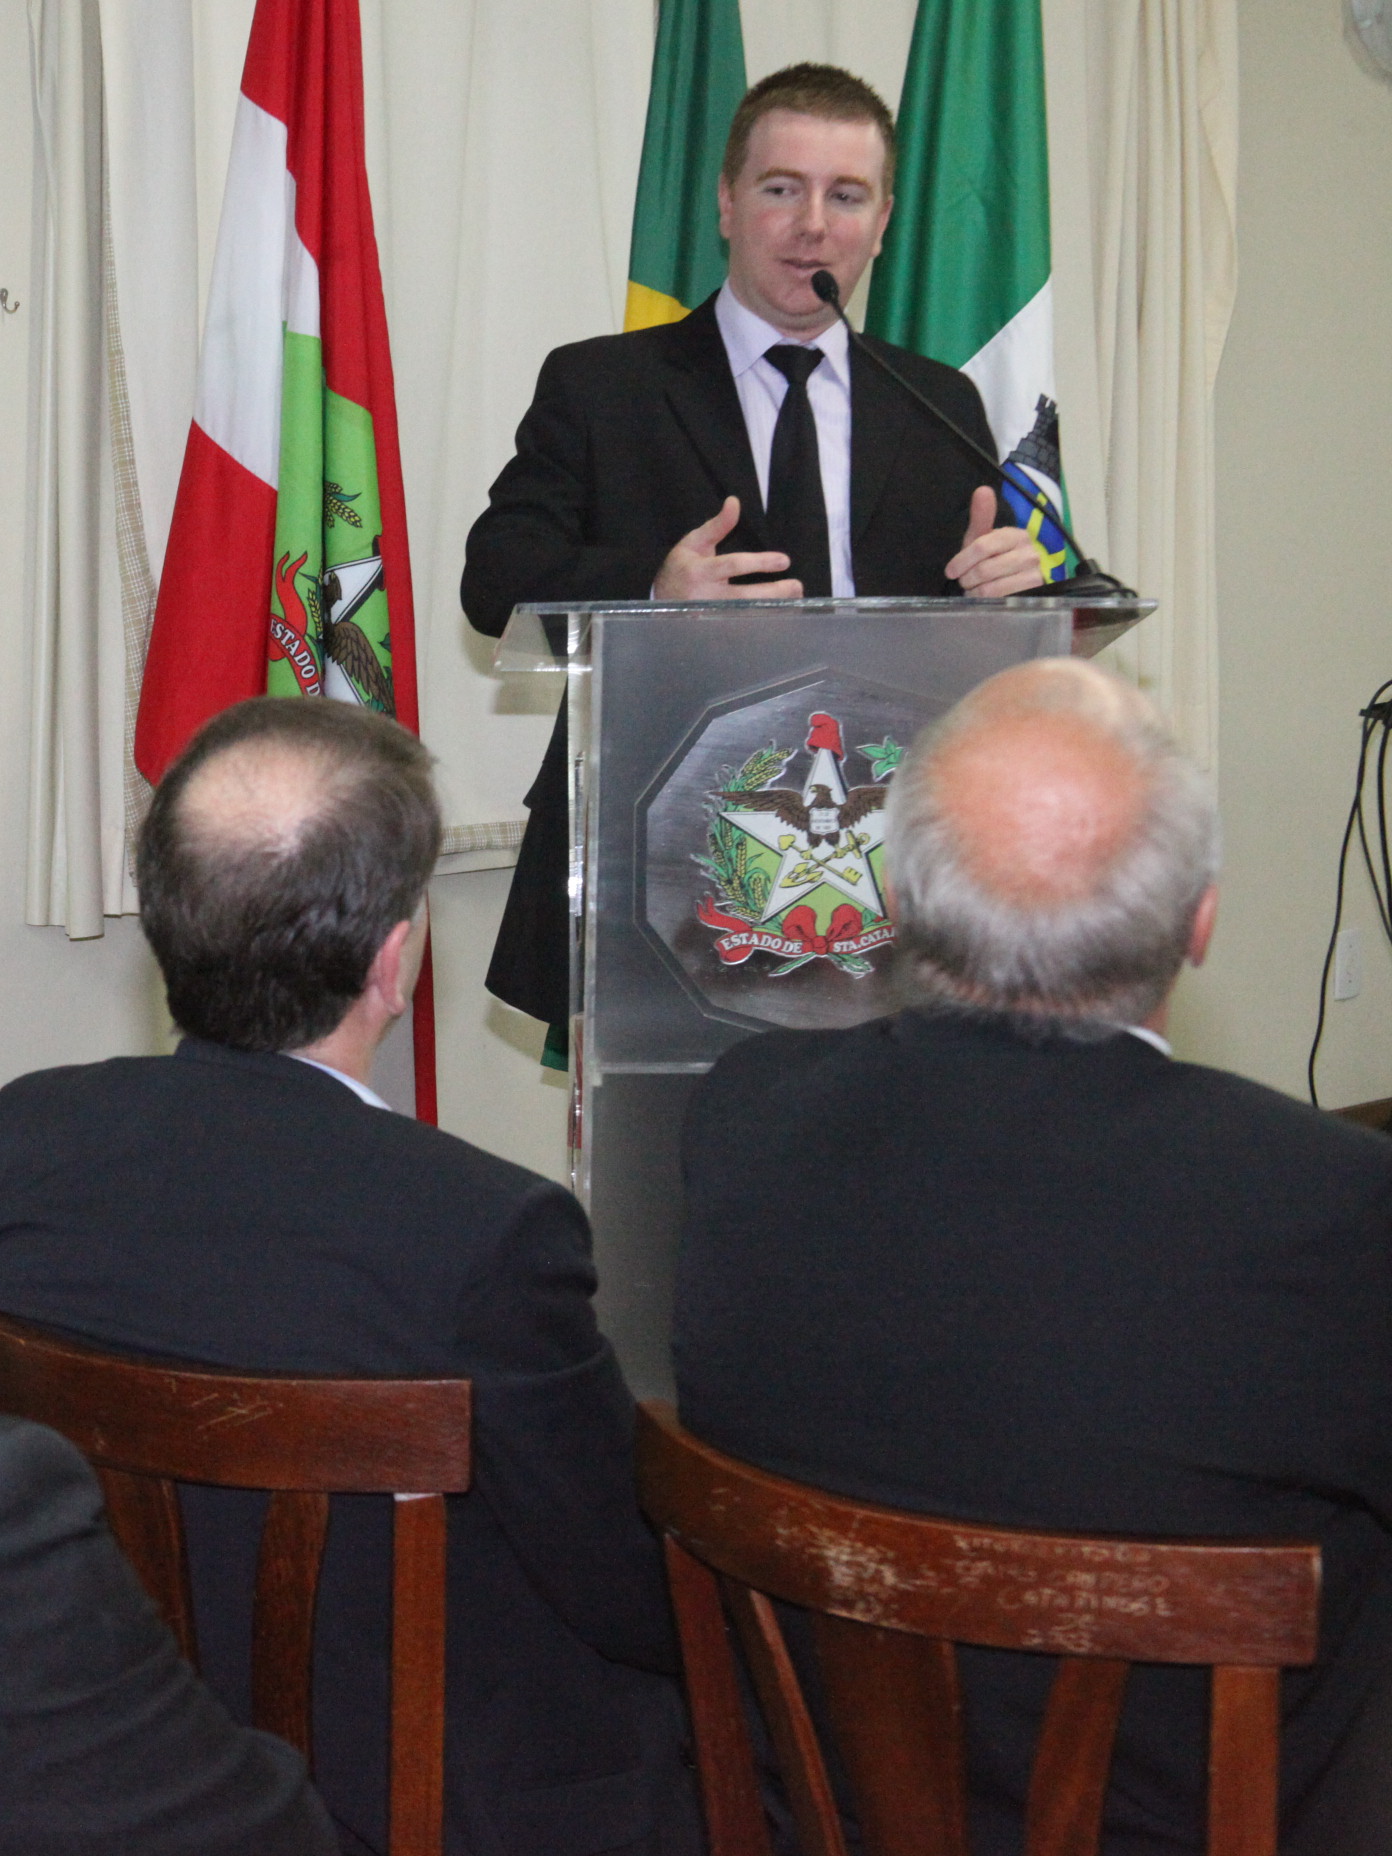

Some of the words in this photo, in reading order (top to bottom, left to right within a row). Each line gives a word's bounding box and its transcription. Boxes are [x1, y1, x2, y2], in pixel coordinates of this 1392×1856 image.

[270, 619, 316, 678] ESTADO
[307, 683, 320, 697] D
[720, 932, 782, 951] ESTADO
[782, 940, 803, 954] DE
